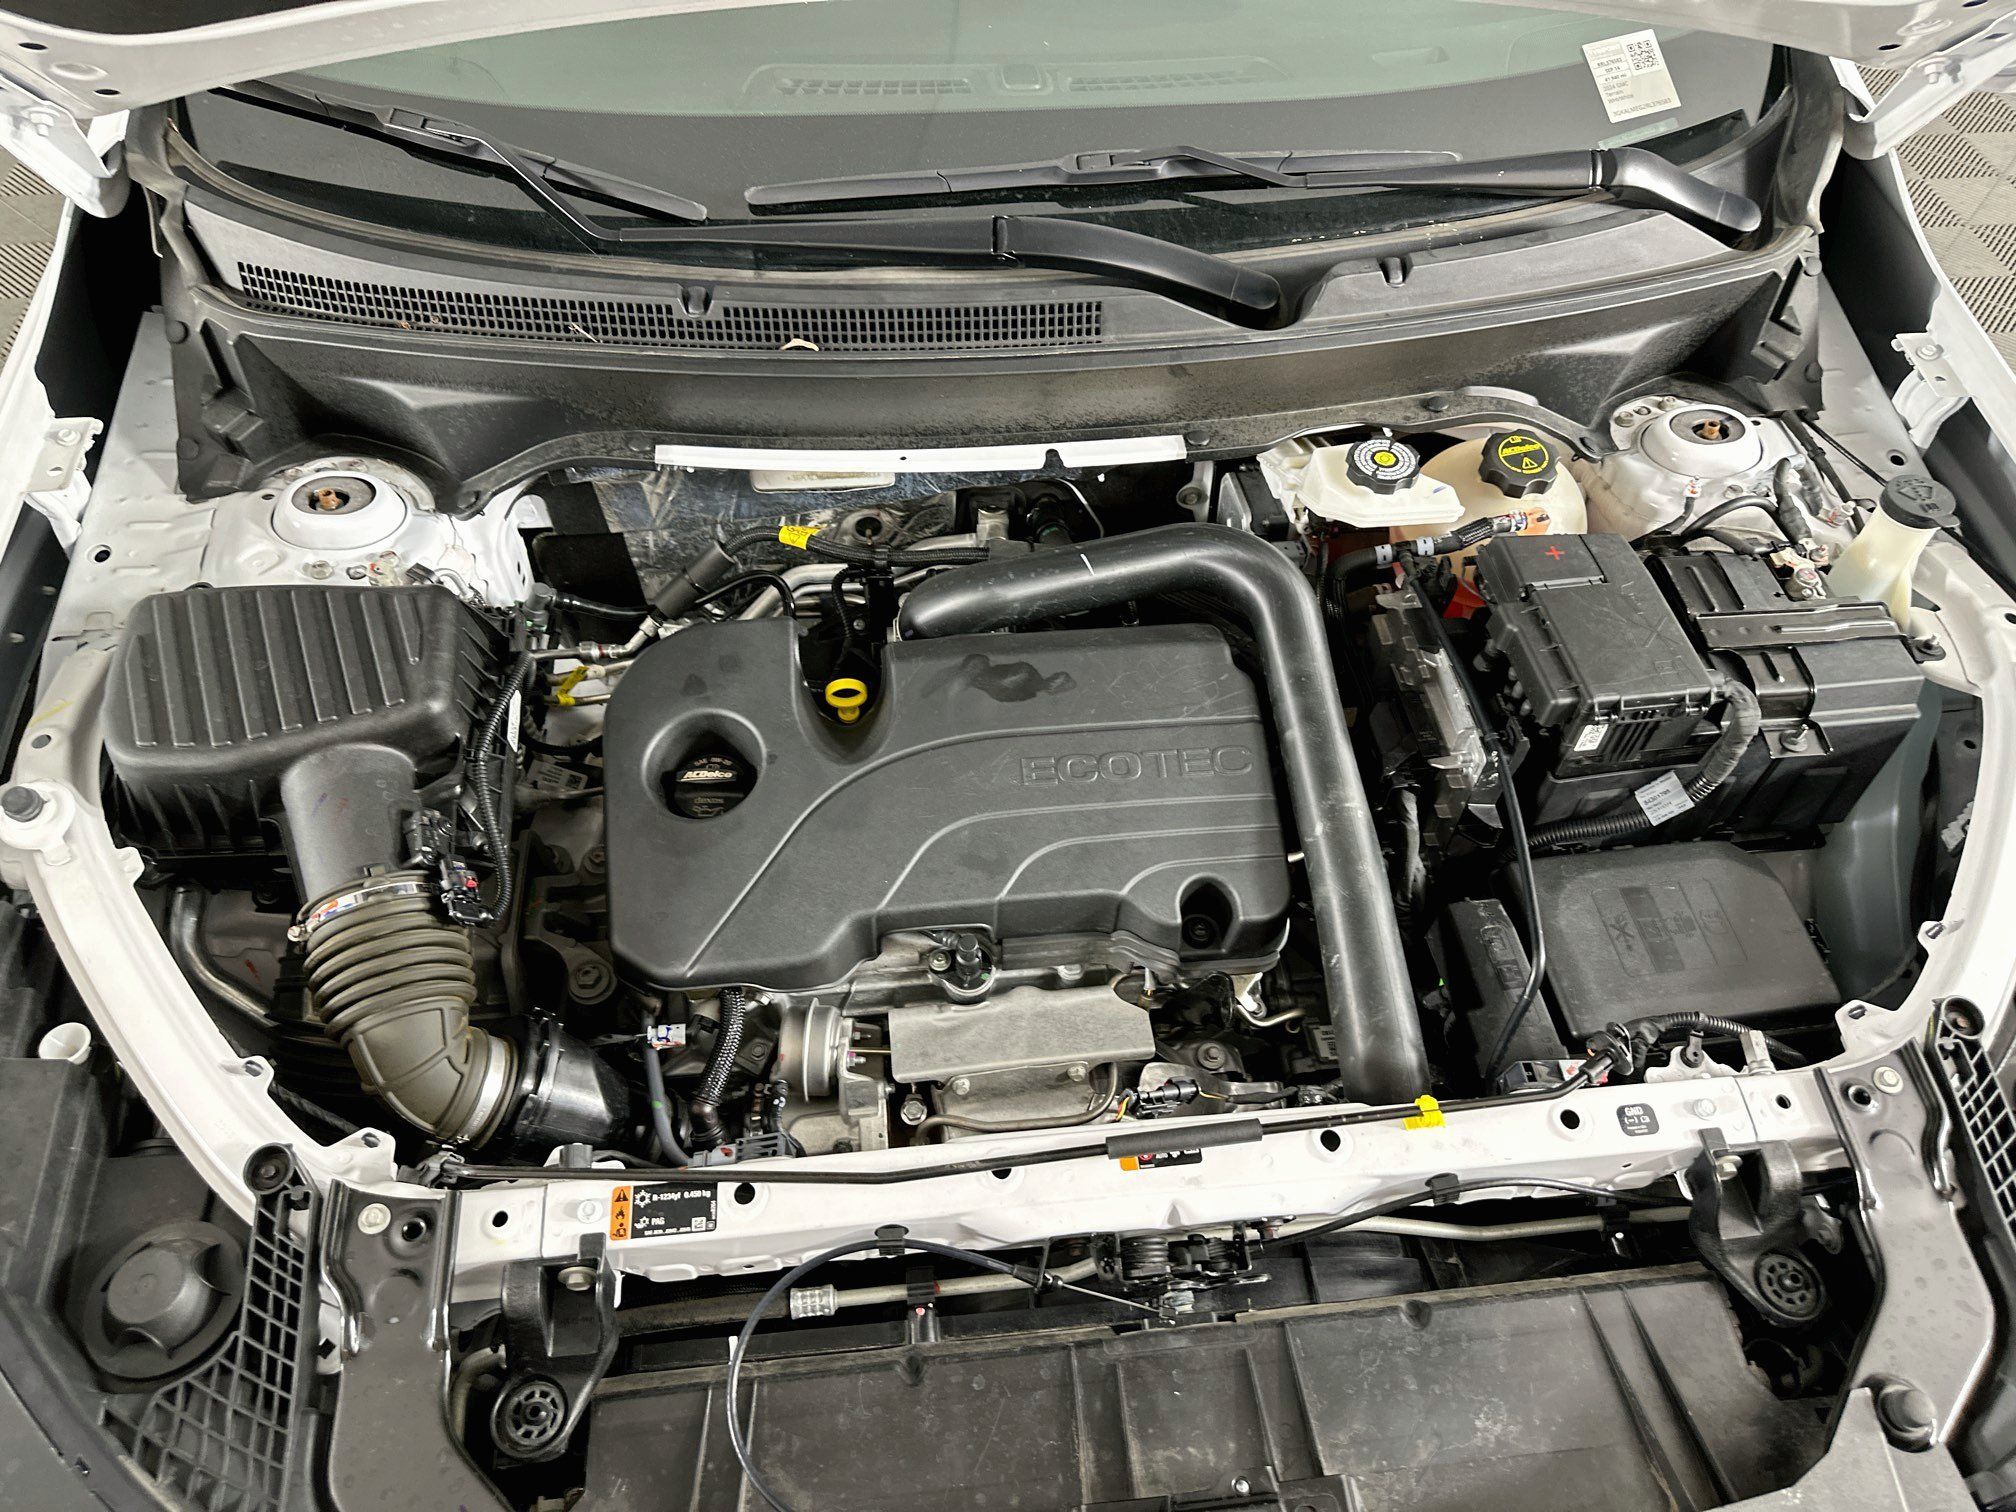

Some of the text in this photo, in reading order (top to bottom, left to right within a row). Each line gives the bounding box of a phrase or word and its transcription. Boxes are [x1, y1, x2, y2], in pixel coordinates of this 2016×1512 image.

[1020, 744, 1253, 787] ECOTEC
[682, 770, 733, 779] ACDelco
[1625, 1106, 1644, 1116] GND
[651, 1217, 665, 1226] PAG
